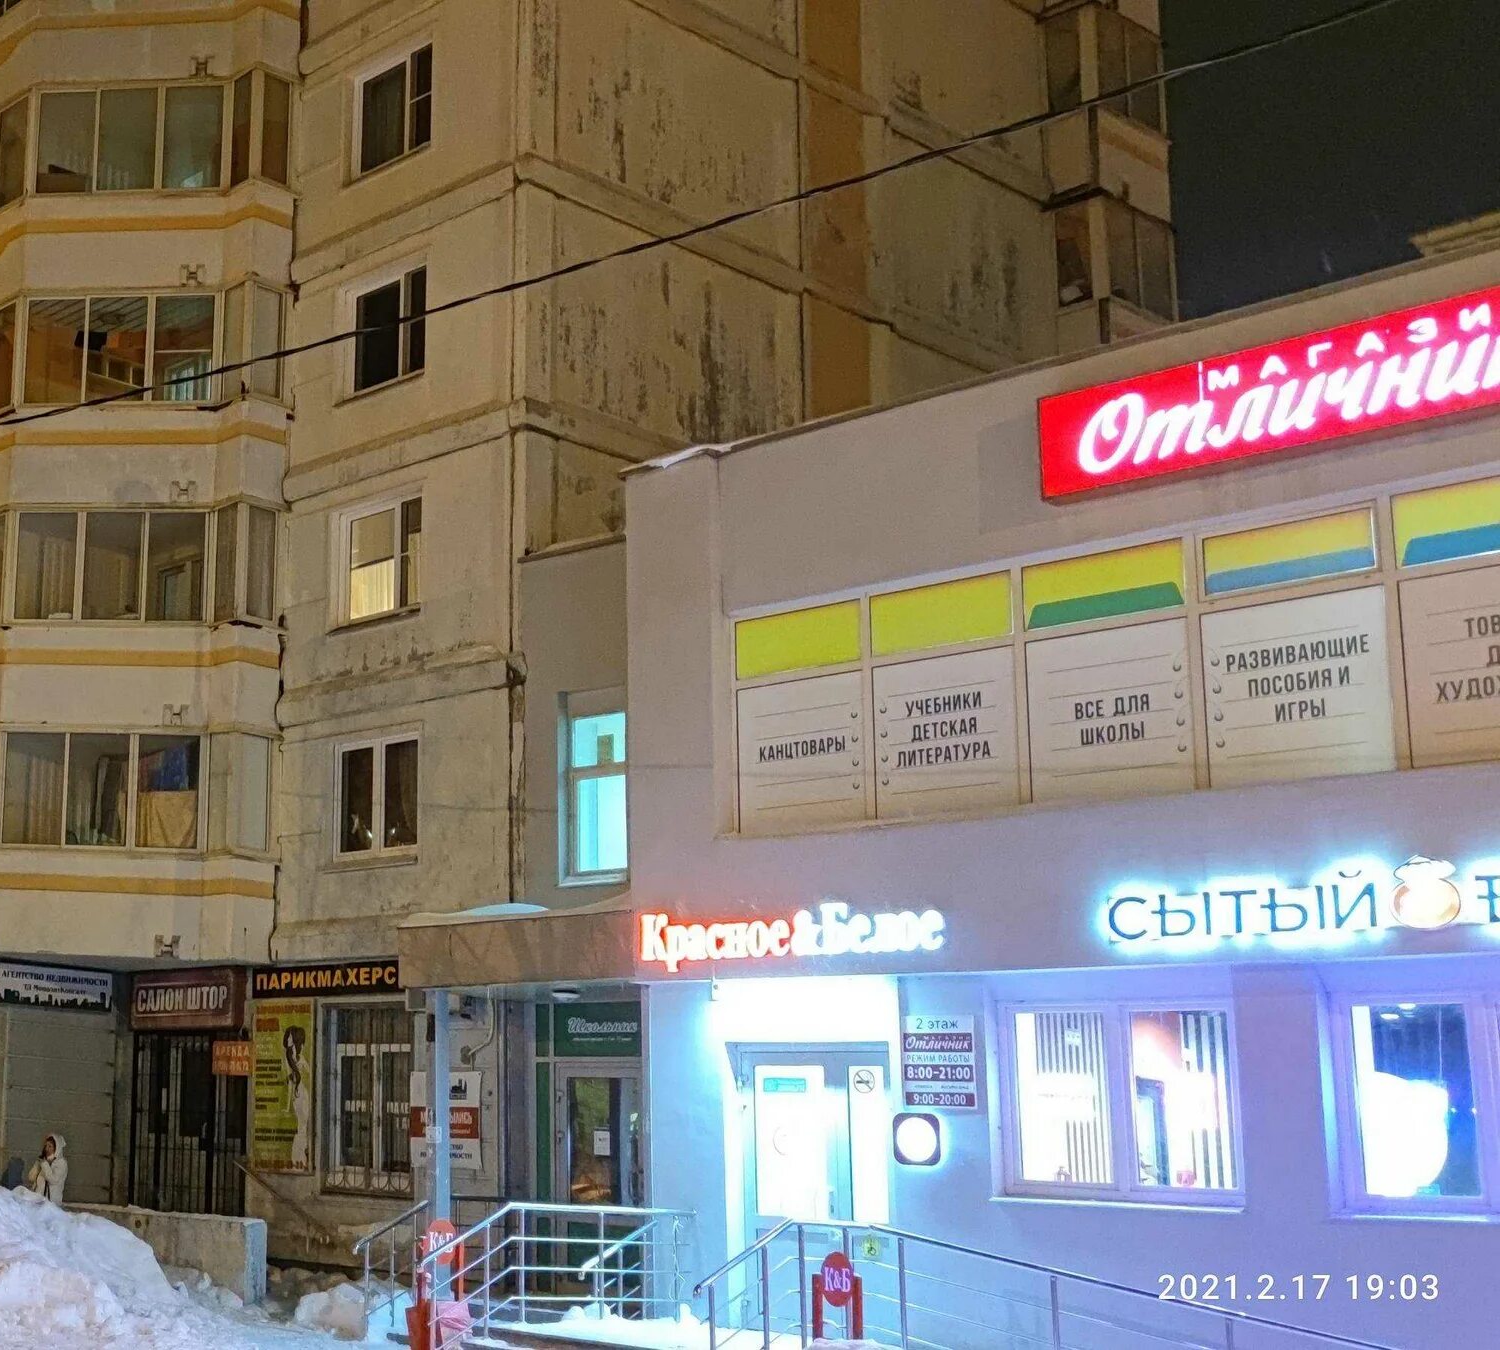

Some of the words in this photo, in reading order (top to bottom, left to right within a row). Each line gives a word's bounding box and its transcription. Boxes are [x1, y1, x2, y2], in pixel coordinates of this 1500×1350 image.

[1226, 633, 1370, 672] РАЗВИВАЮЩИЕ
[1248, 668, 1333, 698] ПОСОБИЯ
[1338, 665, 1351, 685] И
[1436, 675, 1500, 703] ХУДО
[905, 691, 983, 717] УЧЕБНИКИ
[1074, 699, 1105, 721] ВСЕ
[1113, 693, 1150, 717] ДЛЯ
[1274, 698, 1327, 723] ИГРЫ
[911, 716, 978, 743] ДЕТСКАЯ
[1080, 720, 1146, 746] ШКОЛЫ
[759, 735, 847, 762] КАНЦТОВАРЫ
[896, 740, 991, 768] ЛИТЕРАТУРА
[1108, 869, 1378, 941] СЫТЫЙ
[255, 966, 397, 991] ПАРИКМАХЕРС
[137, 987, 184, 1013] САЛОН
[186, 984, 229, 1011] ШТОР
[916, 1017, 923, 1030] 2
[927, 1019, 959, 1030] этаж
[905, 1036, 971, 1050] Отличник
[906, 1054, 936, 1063] РЕЖИМ
[938, 1054, 970, 1063] РАБОТЫ
